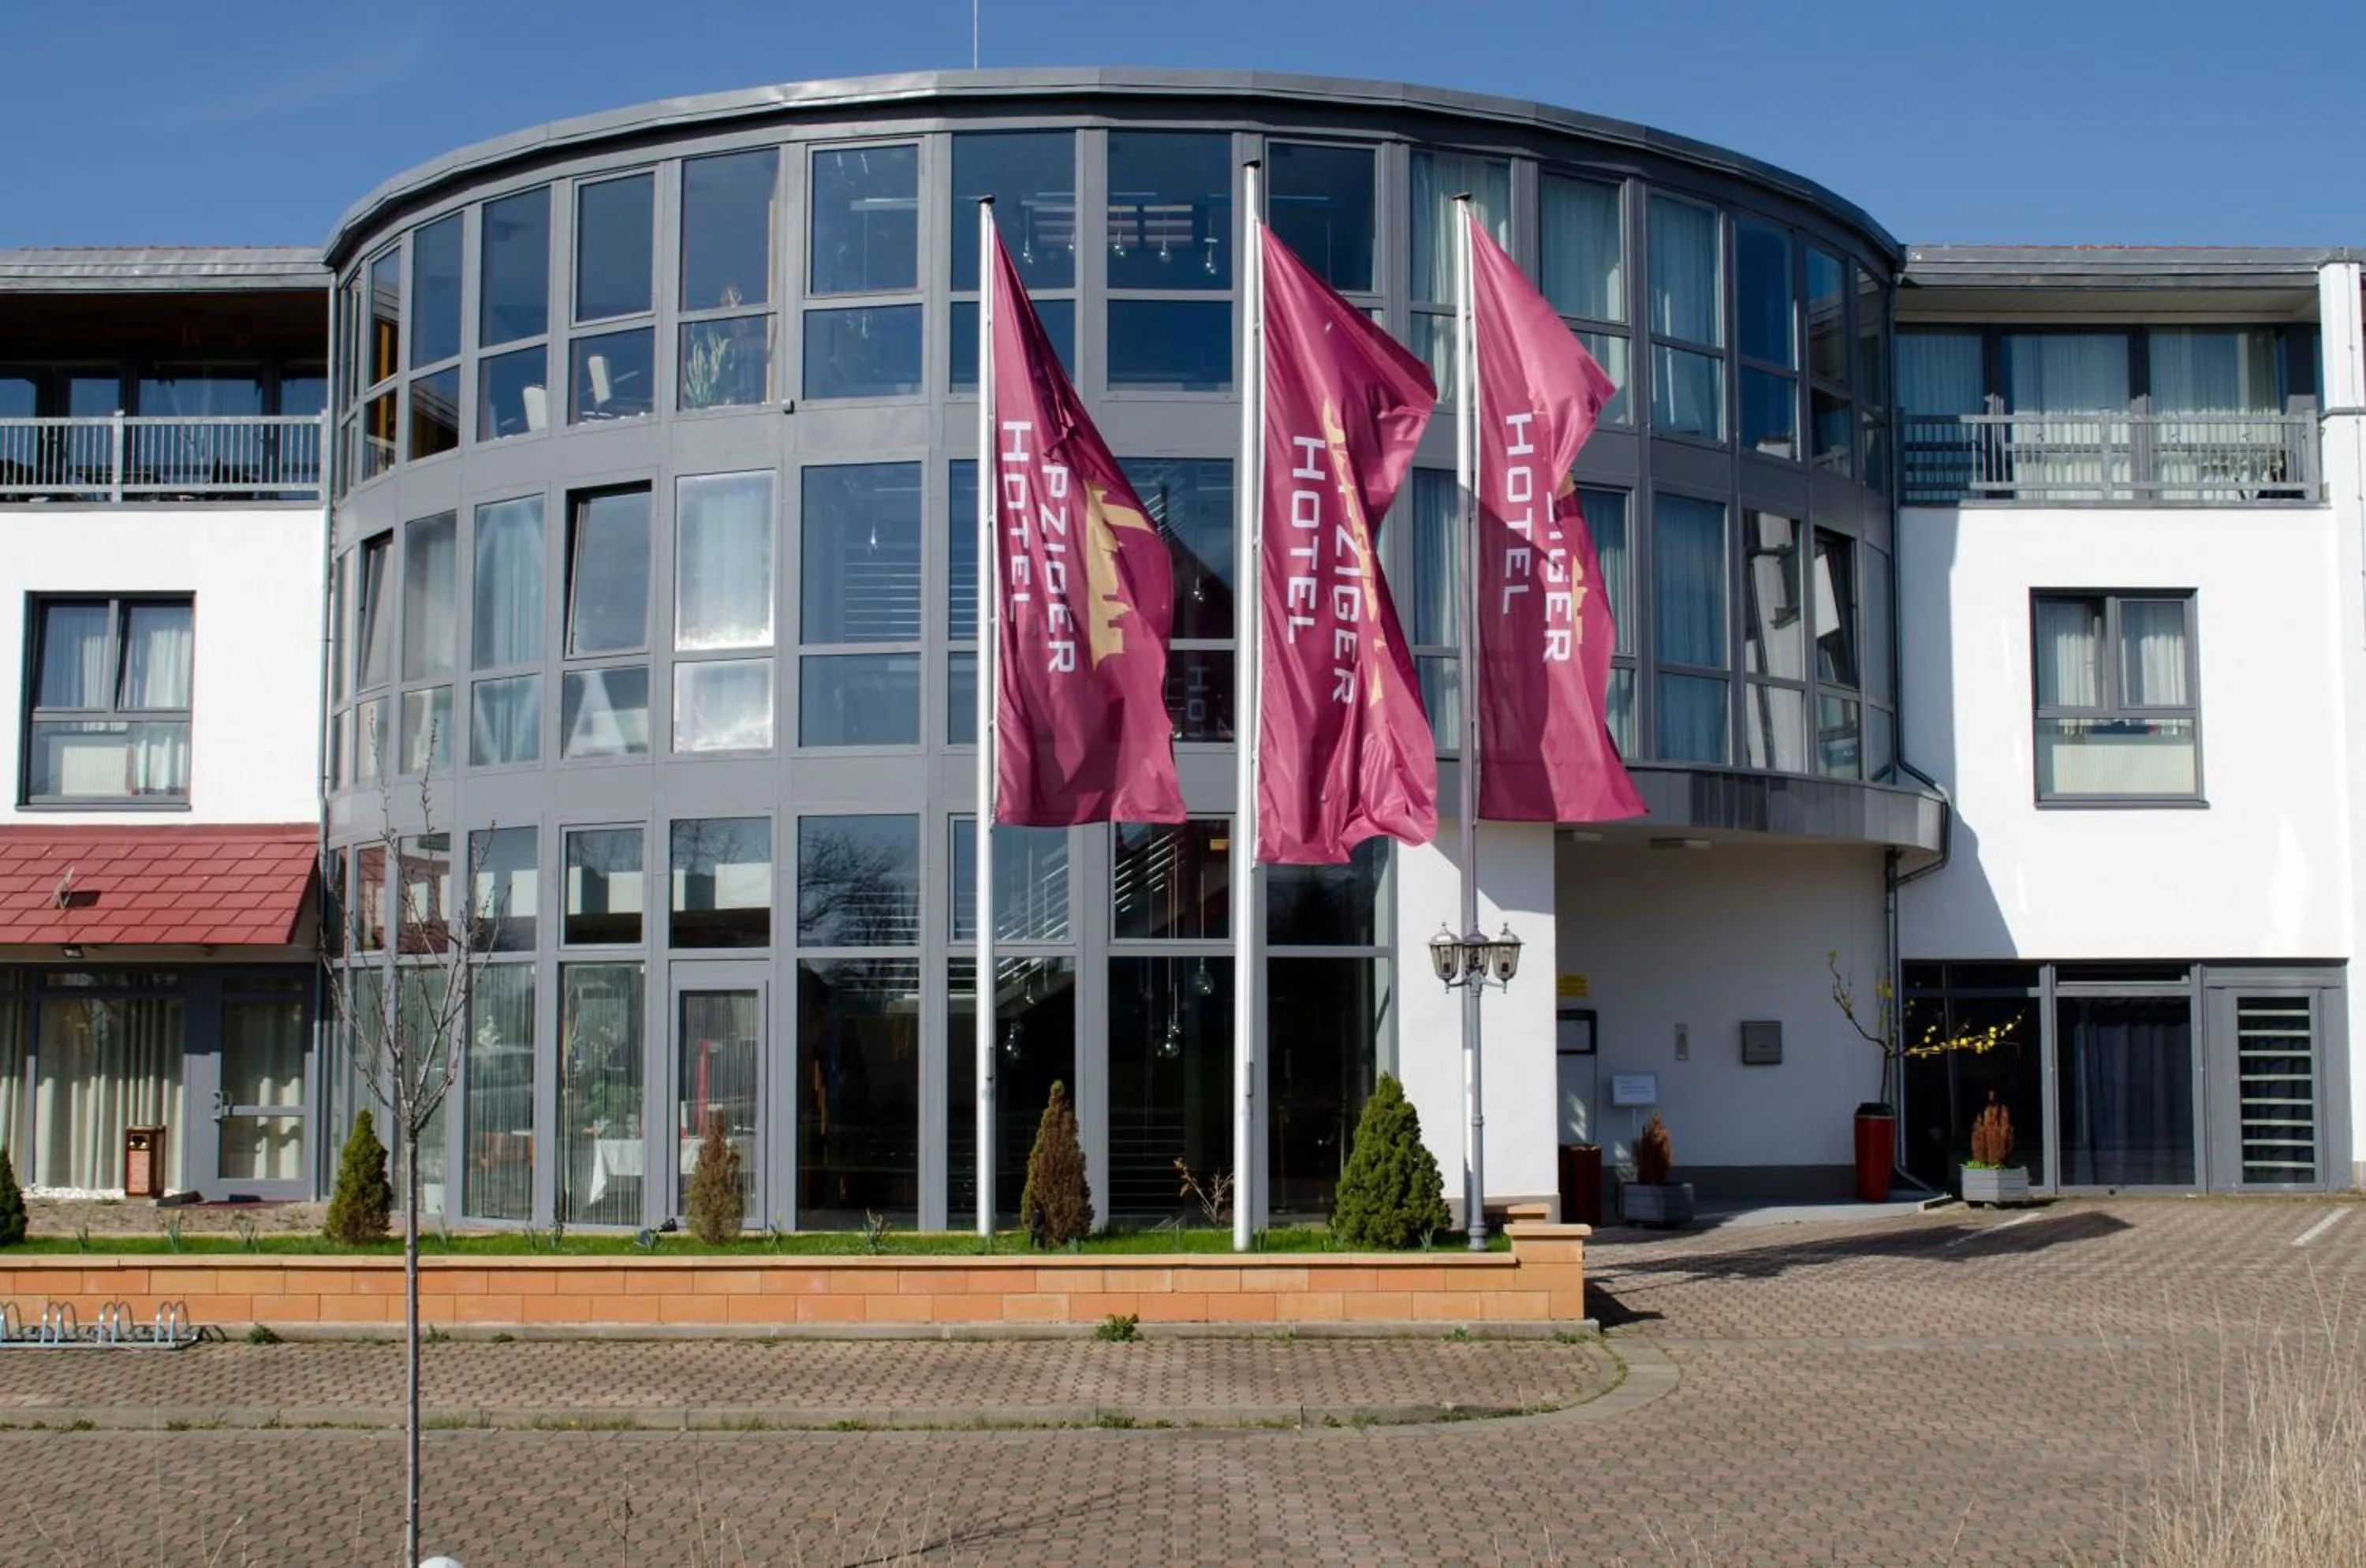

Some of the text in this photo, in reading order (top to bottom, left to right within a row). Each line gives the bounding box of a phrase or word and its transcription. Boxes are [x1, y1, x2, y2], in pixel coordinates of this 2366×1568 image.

[1002, 420, 1032, 622] HOTEL
[1288, 435, 1325, 644] HOTEL
[1502, 413, 1534, 614] HOTEL
